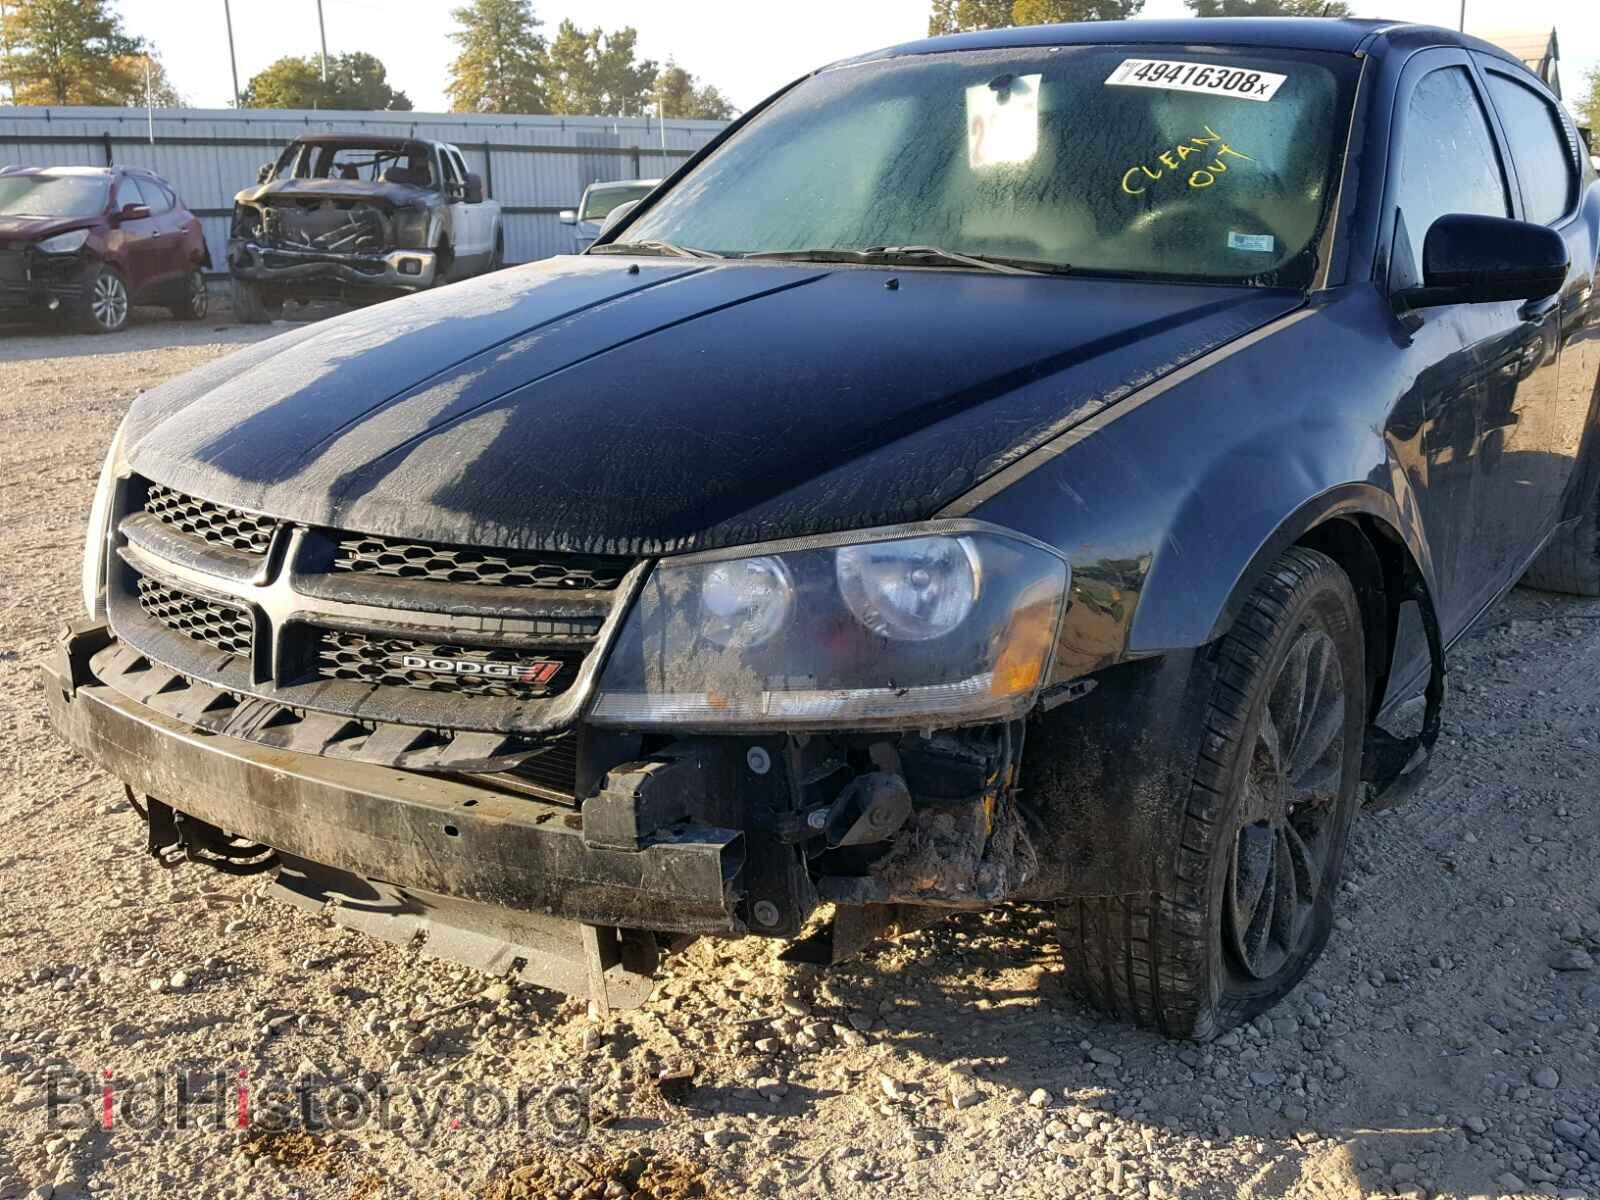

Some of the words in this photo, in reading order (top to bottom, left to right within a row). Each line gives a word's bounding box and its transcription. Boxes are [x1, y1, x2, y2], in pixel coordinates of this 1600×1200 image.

[1122, 125, 1222, 194] CLEAN
[1188, 144, 1256, 187] OUT
[403, 656, 536, 676] DODGE
